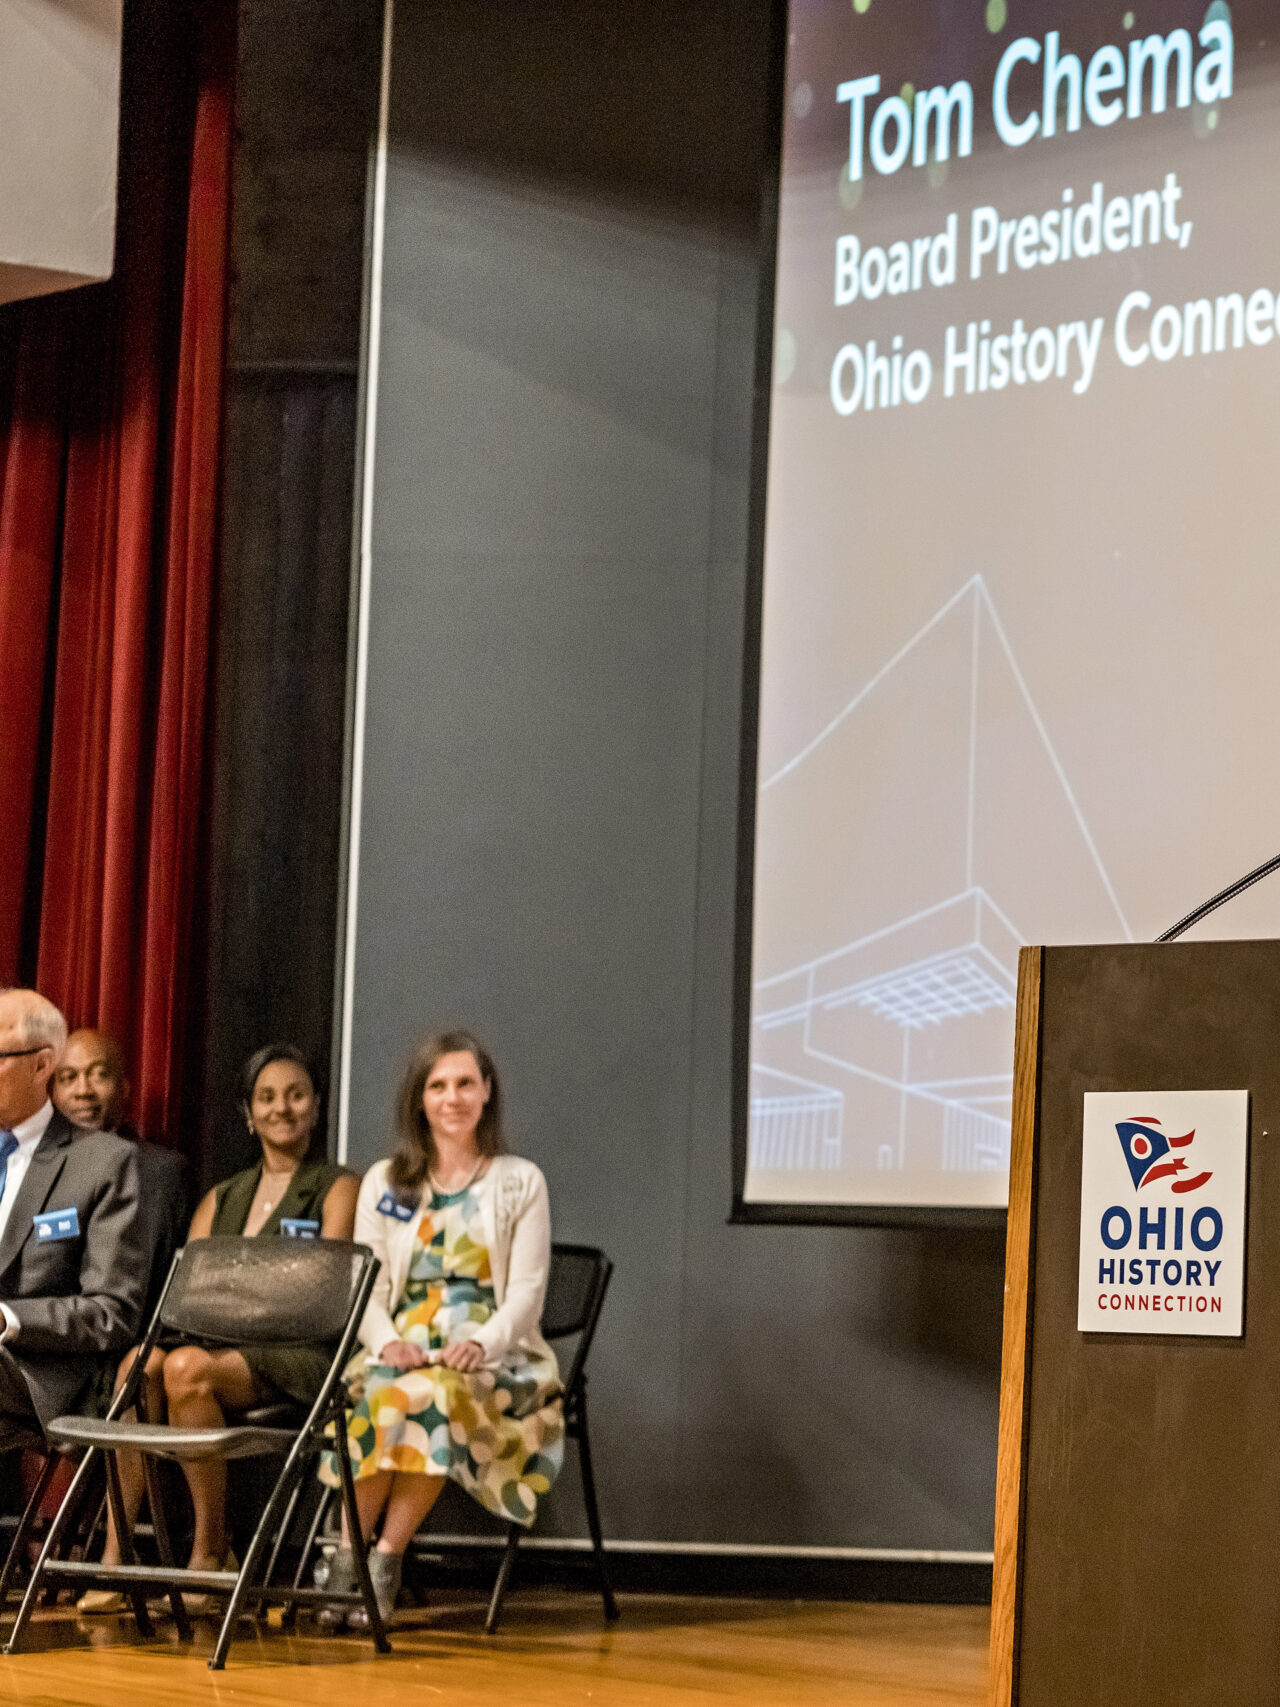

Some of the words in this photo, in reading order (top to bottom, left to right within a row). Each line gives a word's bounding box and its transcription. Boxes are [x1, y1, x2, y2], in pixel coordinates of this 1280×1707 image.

[836, 74, 973, 181] Tom
[993, 19, 1235, 147] Chema
[835, 213, 957, 305] Board
[970, 173, 1192, 279] President,
[830, 336, 932, 416] Ohio
[944, 313, 1104, 394] History
[1100, 1205, 1223, 1252] OHIO
[1098, 1258, 1222, 1286] HISTORY
[1098, 1293, 1222, 1313] CONNECTION
